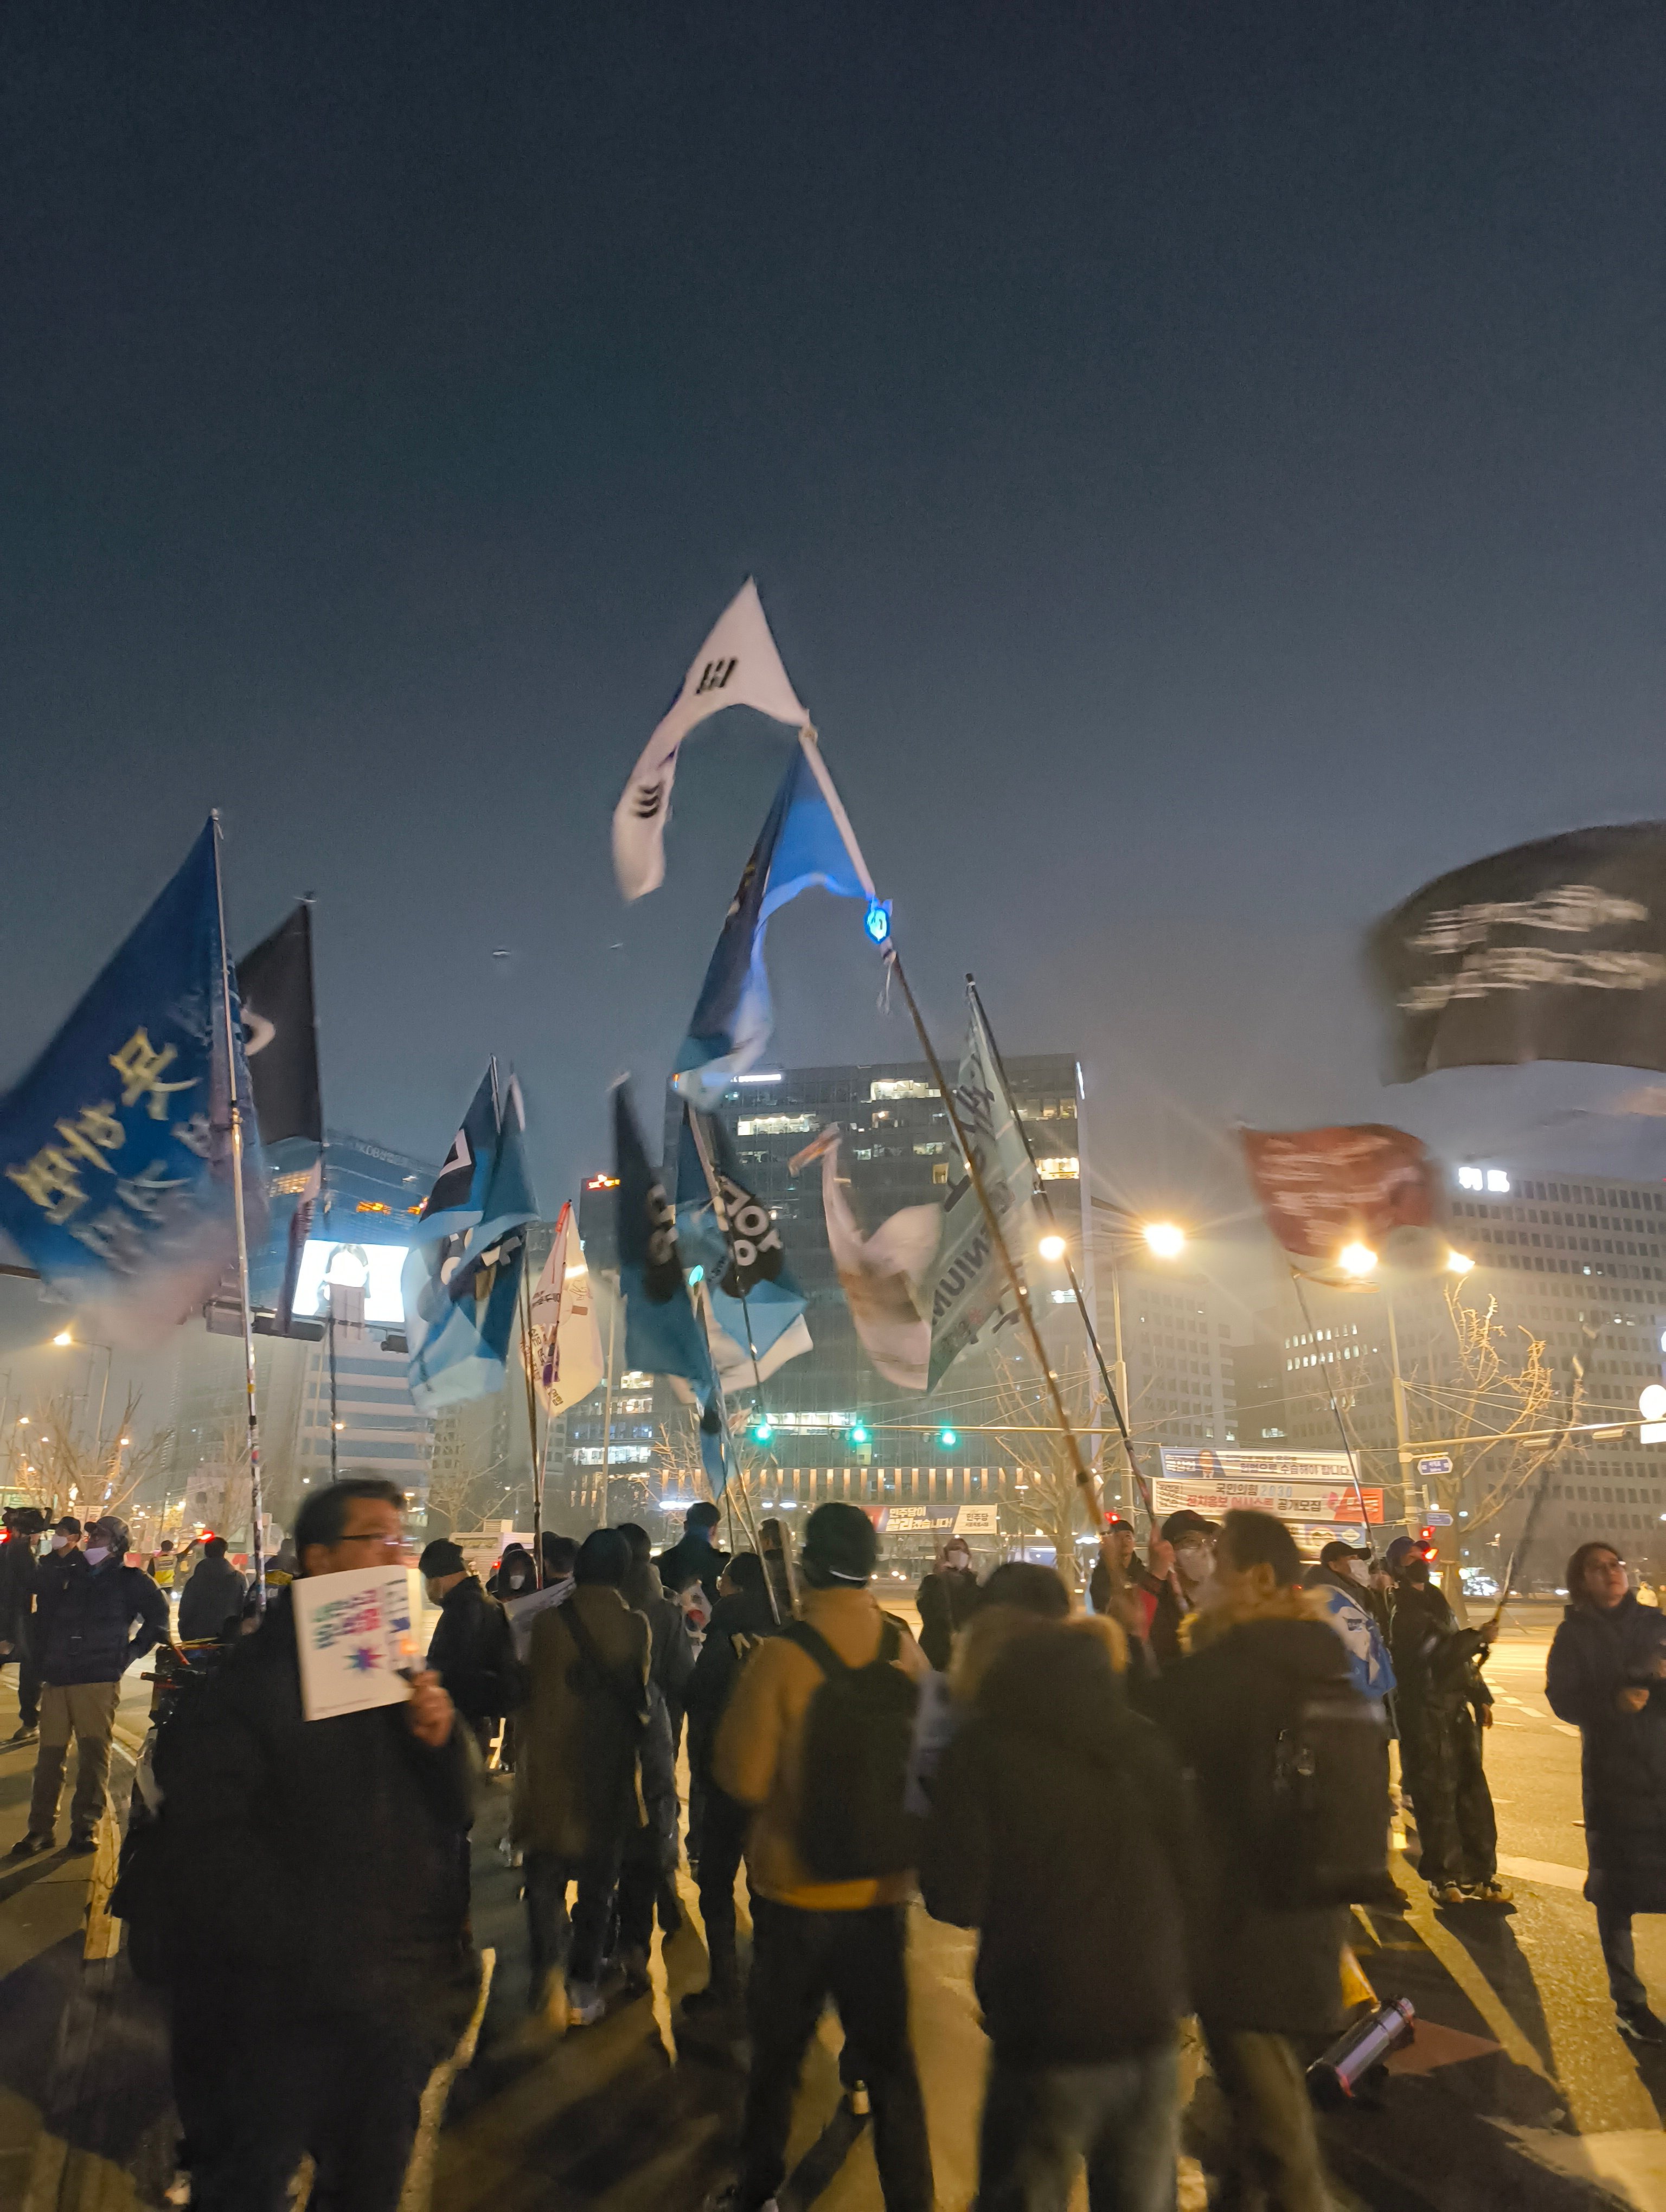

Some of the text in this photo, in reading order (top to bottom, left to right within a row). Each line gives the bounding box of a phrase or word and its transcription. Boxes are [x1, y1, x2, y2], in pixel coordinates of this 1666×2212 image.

[1240, 1462, 1277, 1473] 헌법으로
[1280, 1463, 1318, 1475] 수습해야
[1215, 1483, 1292, 1497] 국민의힘 2030
[1278, 1498, 1321, 1512] 공개모집
[889, 1506, 926, 1518] 민주당이
[966, 1513, 989, 1521] 민주당
[886, 1517, 953, 1532] 살리겠습니다!
